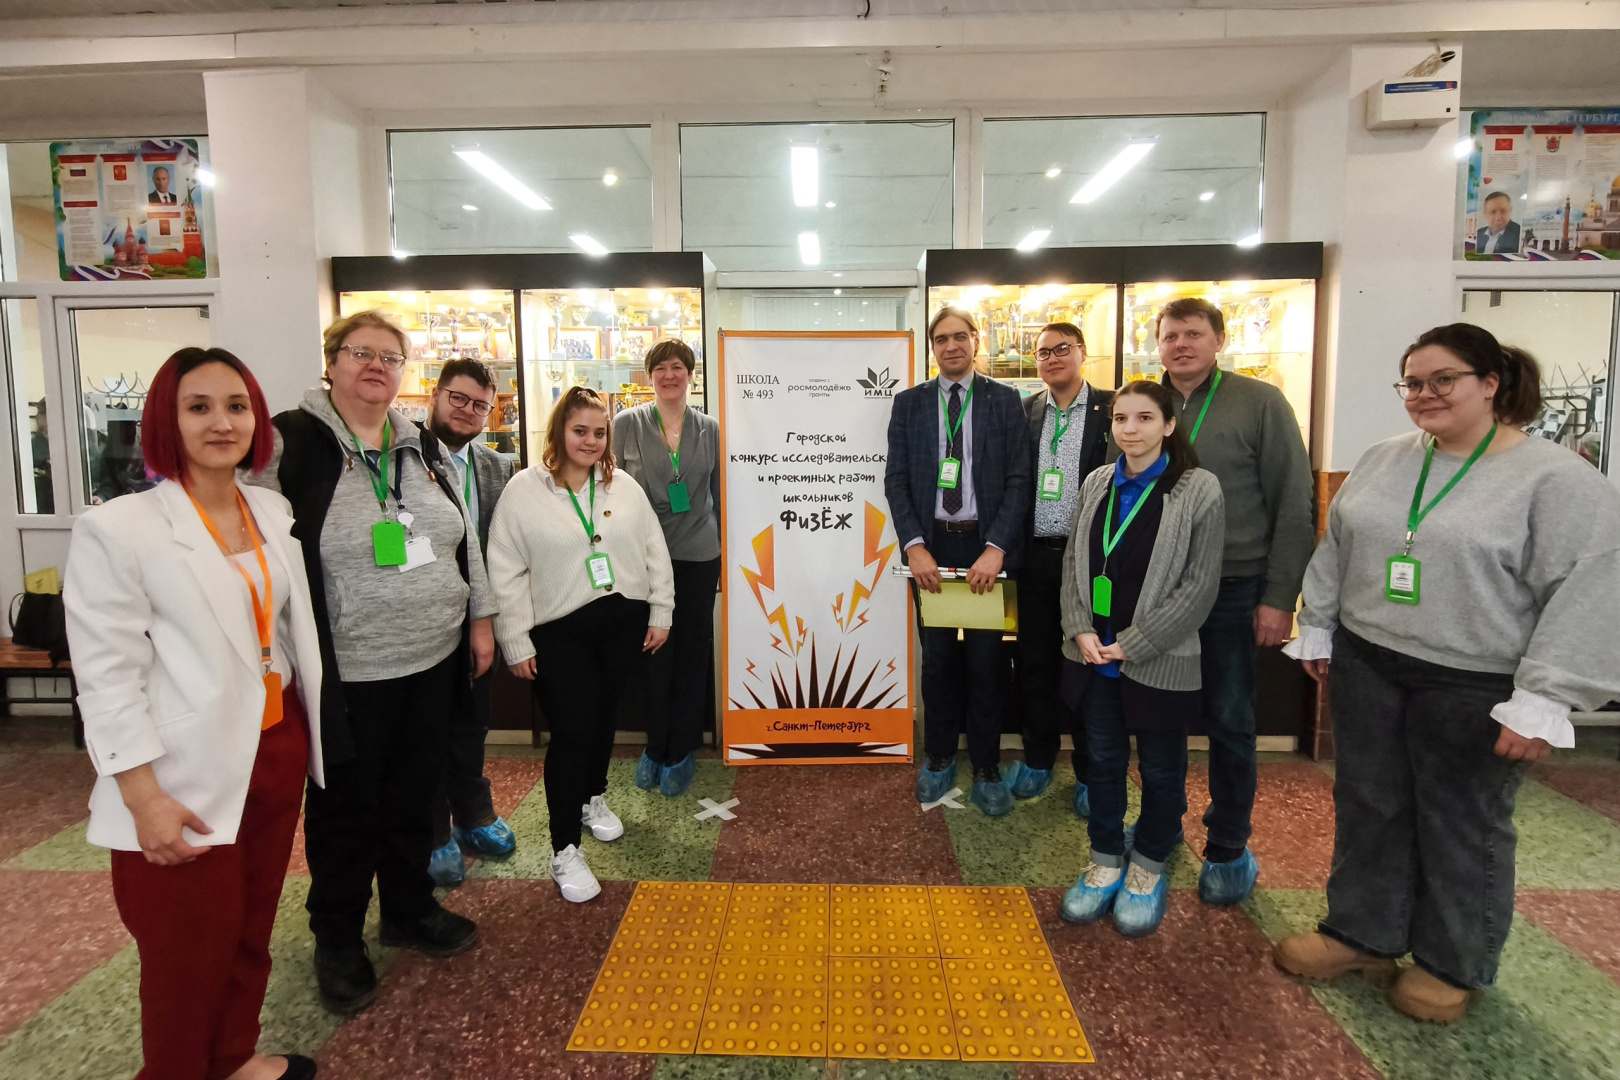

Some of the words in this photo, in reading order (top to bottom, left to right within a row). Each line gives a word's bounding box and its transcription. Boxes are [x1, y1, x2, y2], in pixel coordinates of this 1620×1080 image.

[736, 374, 780, 385] ШКОЛА
[787, 384, 851, 393] росмолодёжь
[864, 389, 893, 397] ИМЦ
[742, 389, 754, 399] №
[756, 389, 774, 400] 493
[785, 431, 846, 445] Городской
[730, 453, 778, 466] конкурс
[782, 452, 886, 466] исследовательск
[768, 474, 836, 485] проектных
[838, 473, 876, 485] работ
[783, 491, 854, 503] школьников
